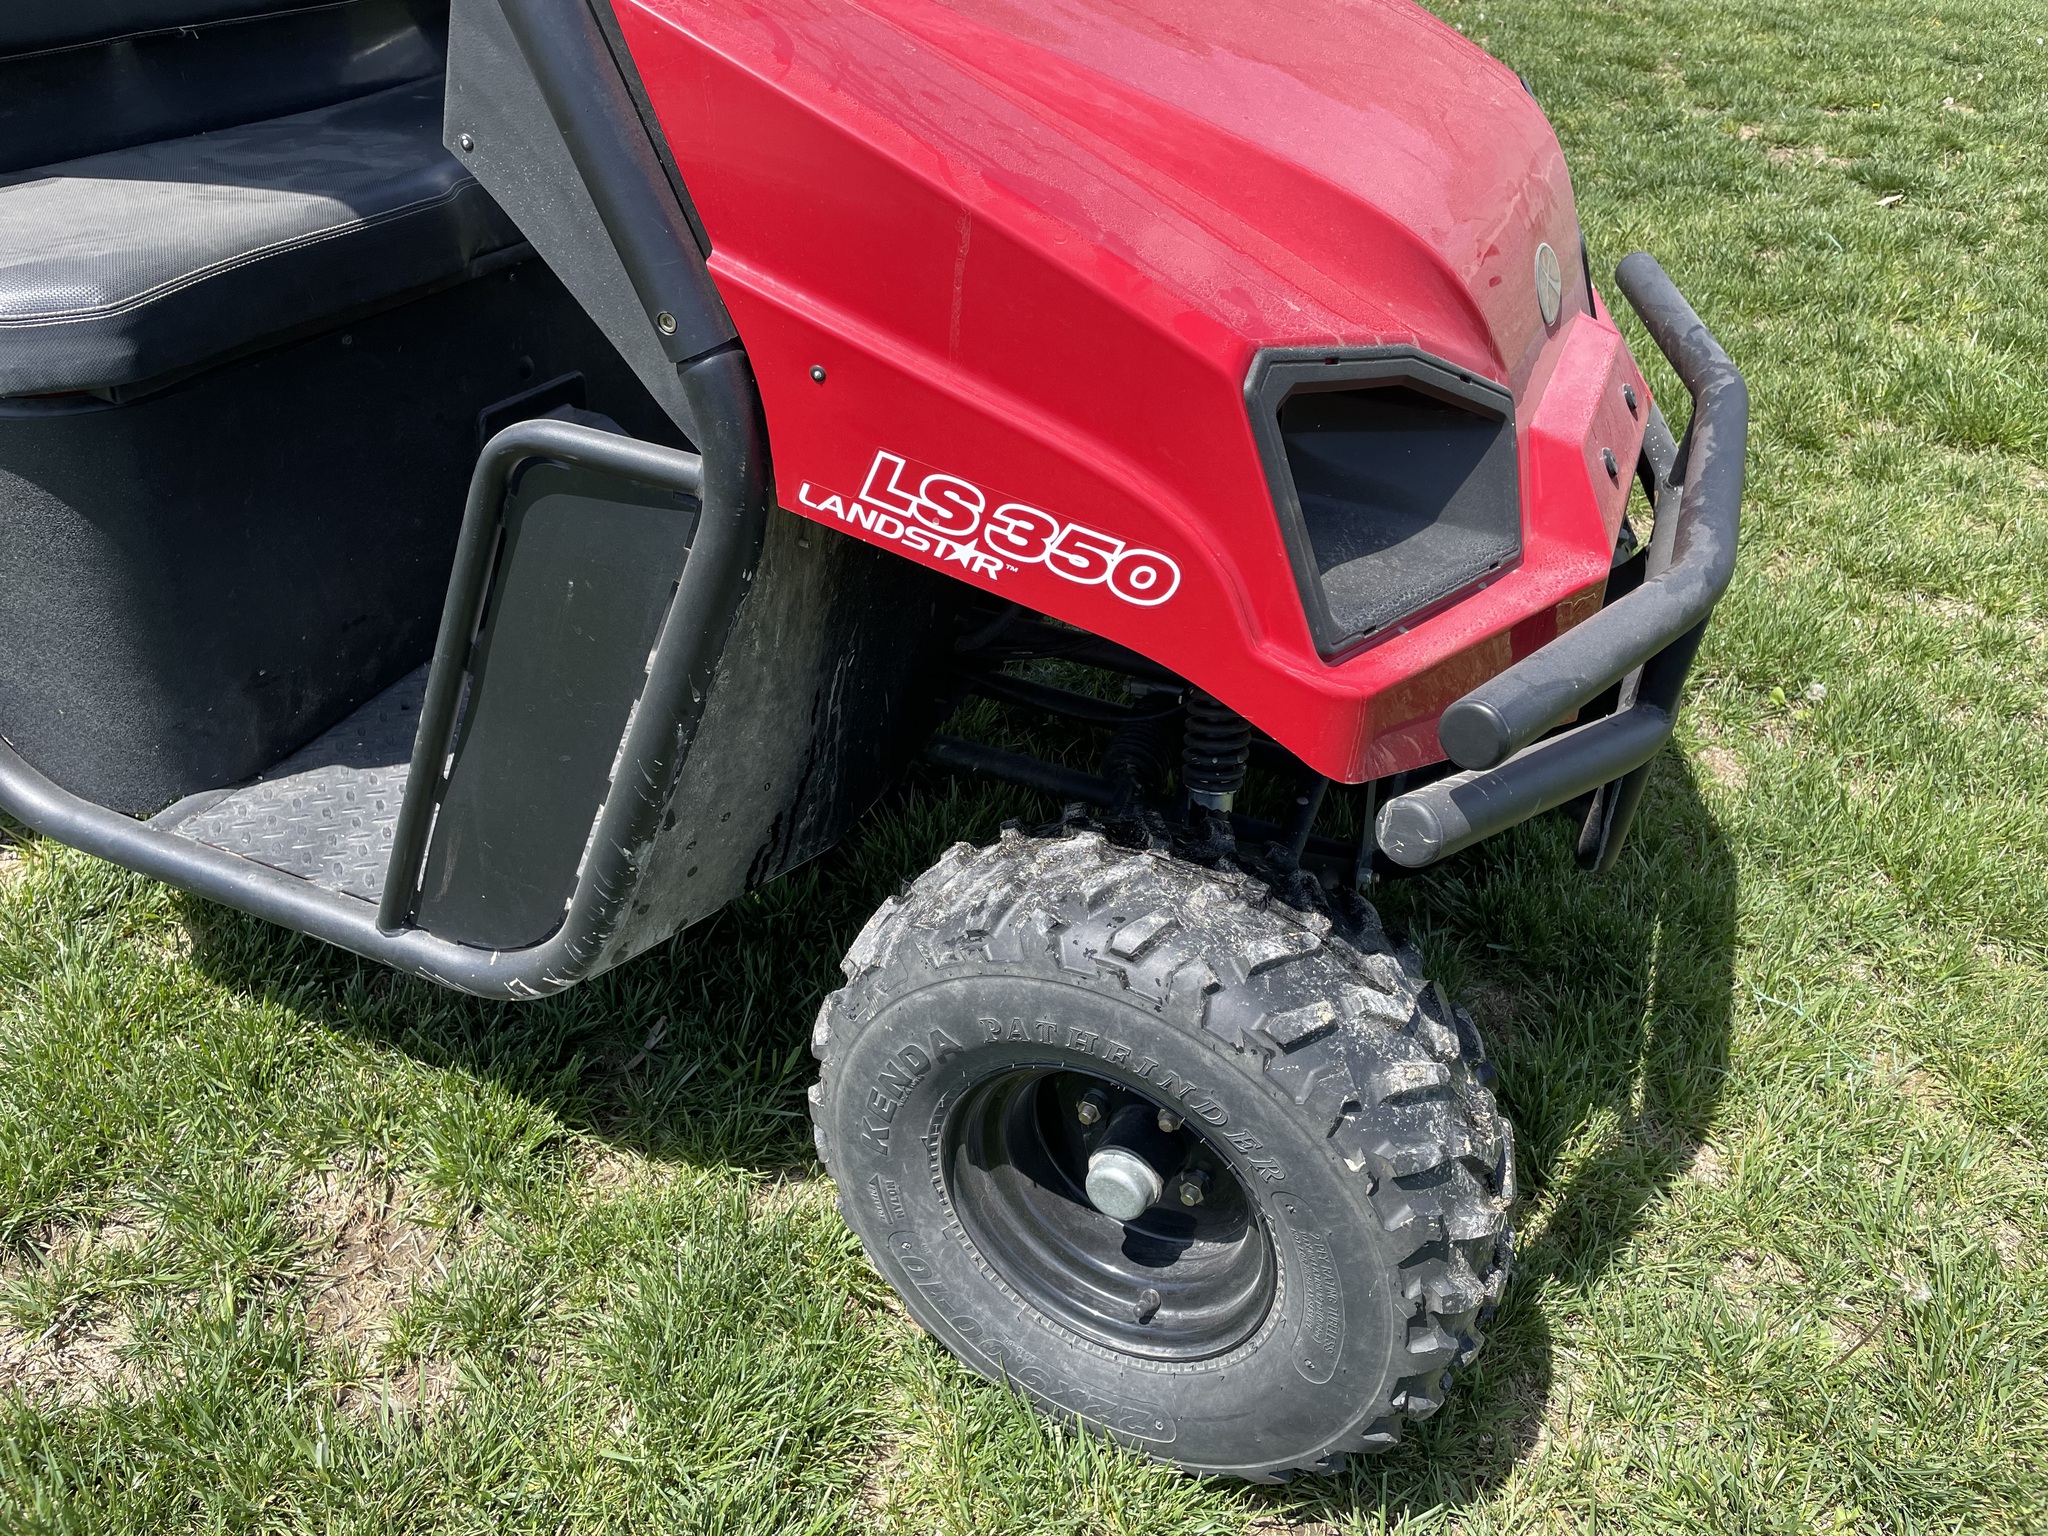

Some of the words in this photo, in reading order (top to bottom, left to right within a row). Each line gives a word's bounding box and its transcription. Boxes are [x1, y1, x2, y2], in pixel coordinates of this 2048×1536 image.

[861, 1028, 964, 1156] KENDA
[979, 1017, 1287, 1184] PATHFINDER
[1314, 1243, 1331, 1263] PLY
[1321, 1265, 1338, 1304] RATING
[1323, 1306, 1339, 1354] TUBELESS
